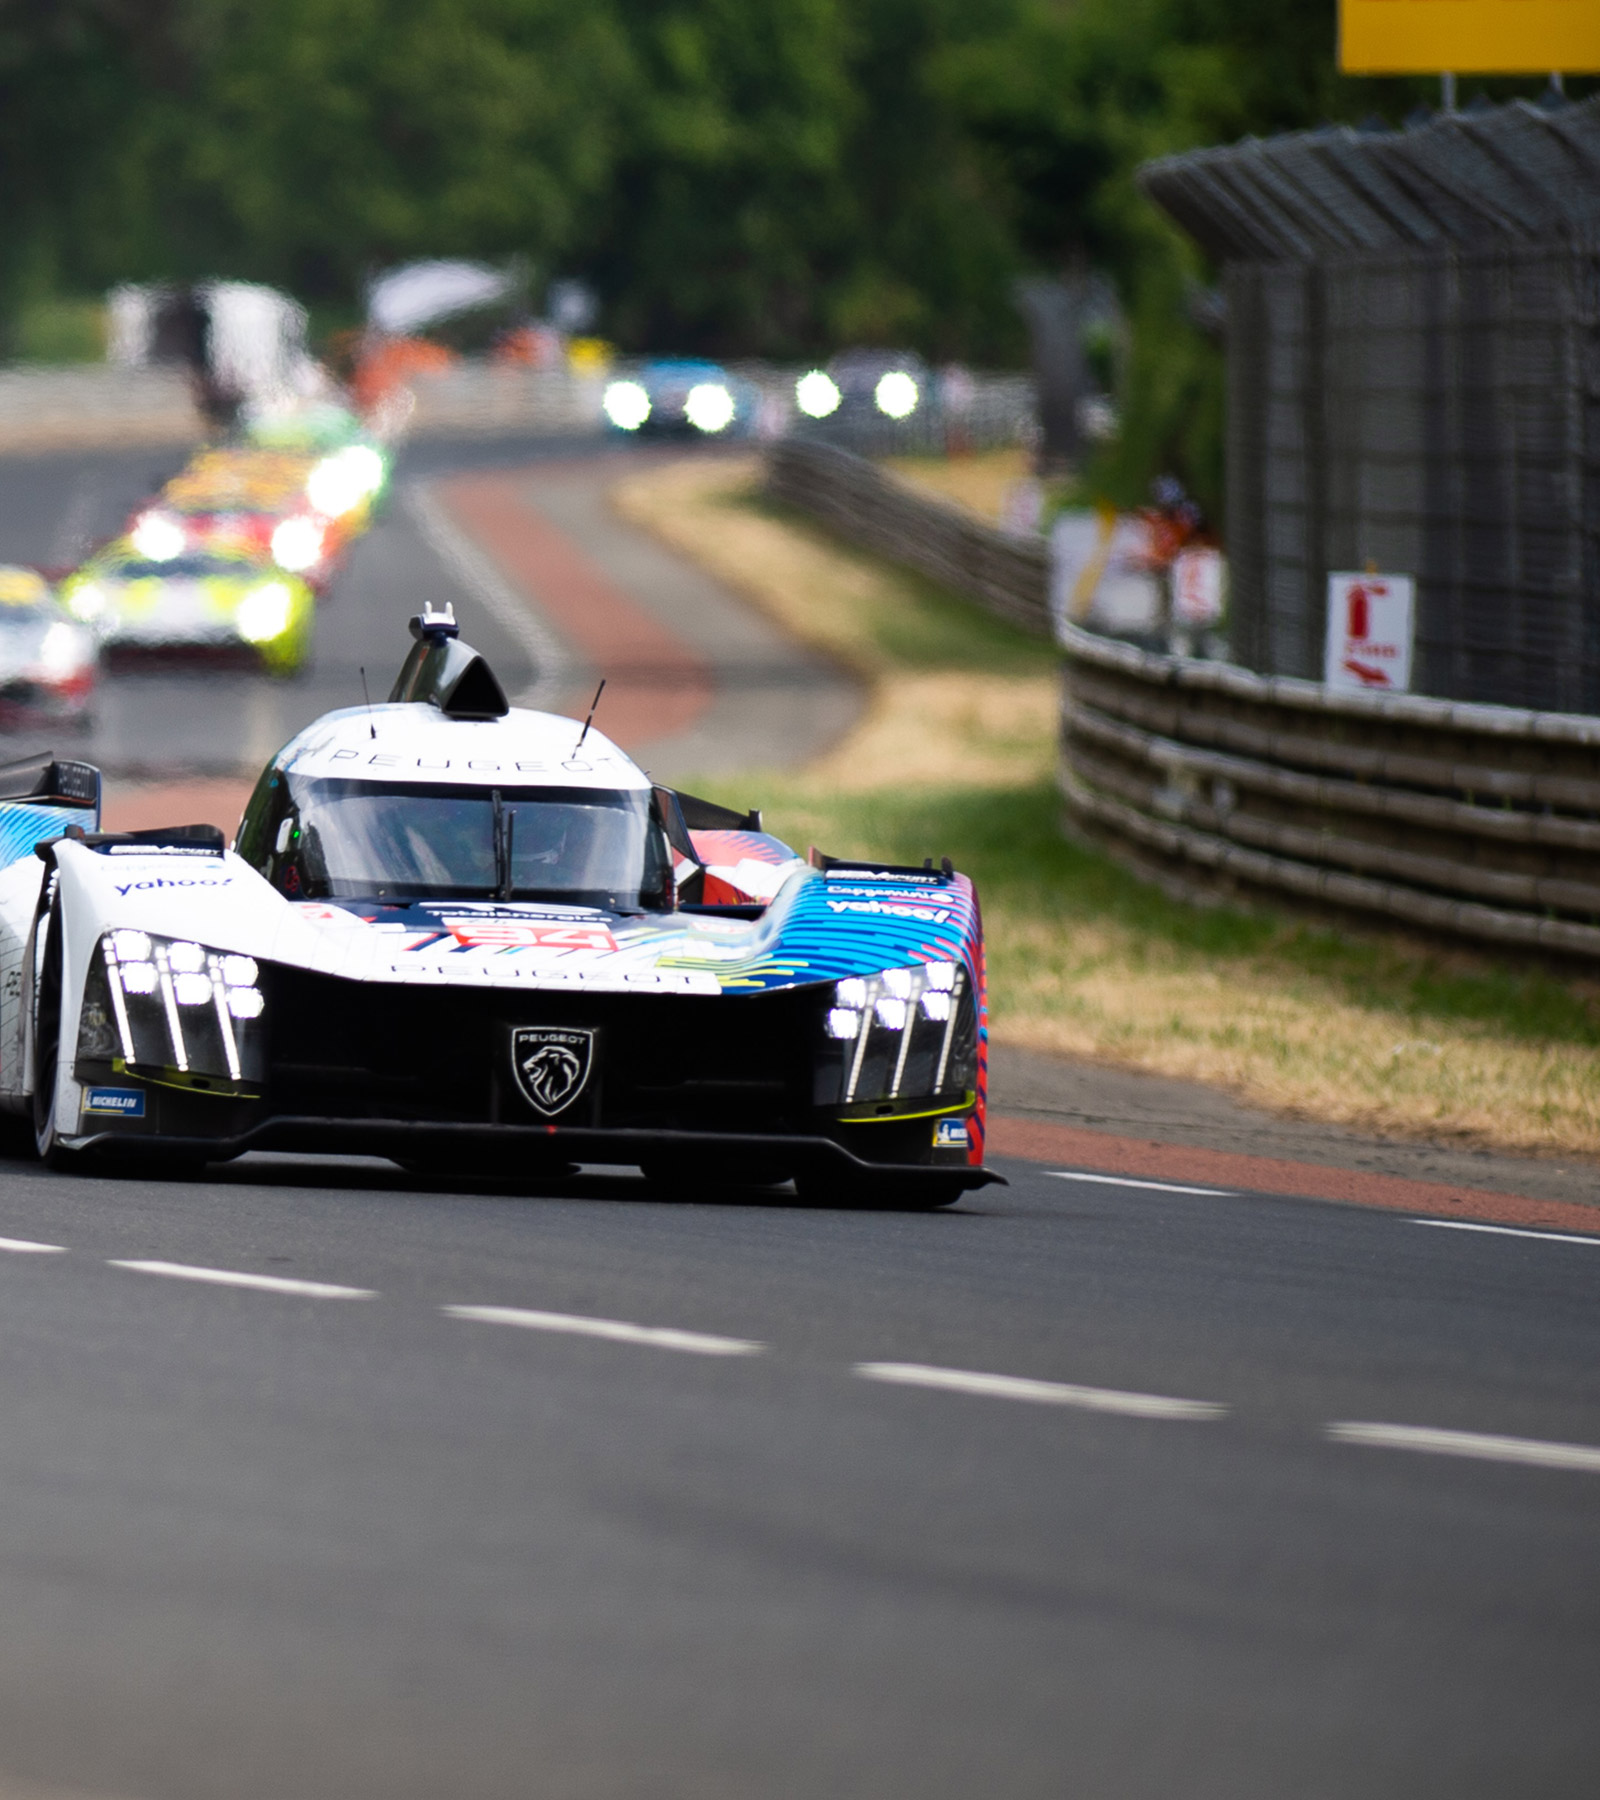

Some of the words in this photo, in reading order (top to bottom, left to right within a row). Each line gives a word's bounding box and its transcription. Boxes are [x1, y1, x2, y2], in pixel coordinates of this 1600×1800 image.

[328, 749, 613, 772] PEUGEOT
[114, 878, 233, 896] yahoo!
[426, 910, 613, 922] TotalEnergies
[826, 900, 951, 924] yahoo!
[457, 926, 612, 949] 94
[518, 1034, 586, 1044] PEUGEOT
[91, 1096, 137, 1108] MICHELIN
